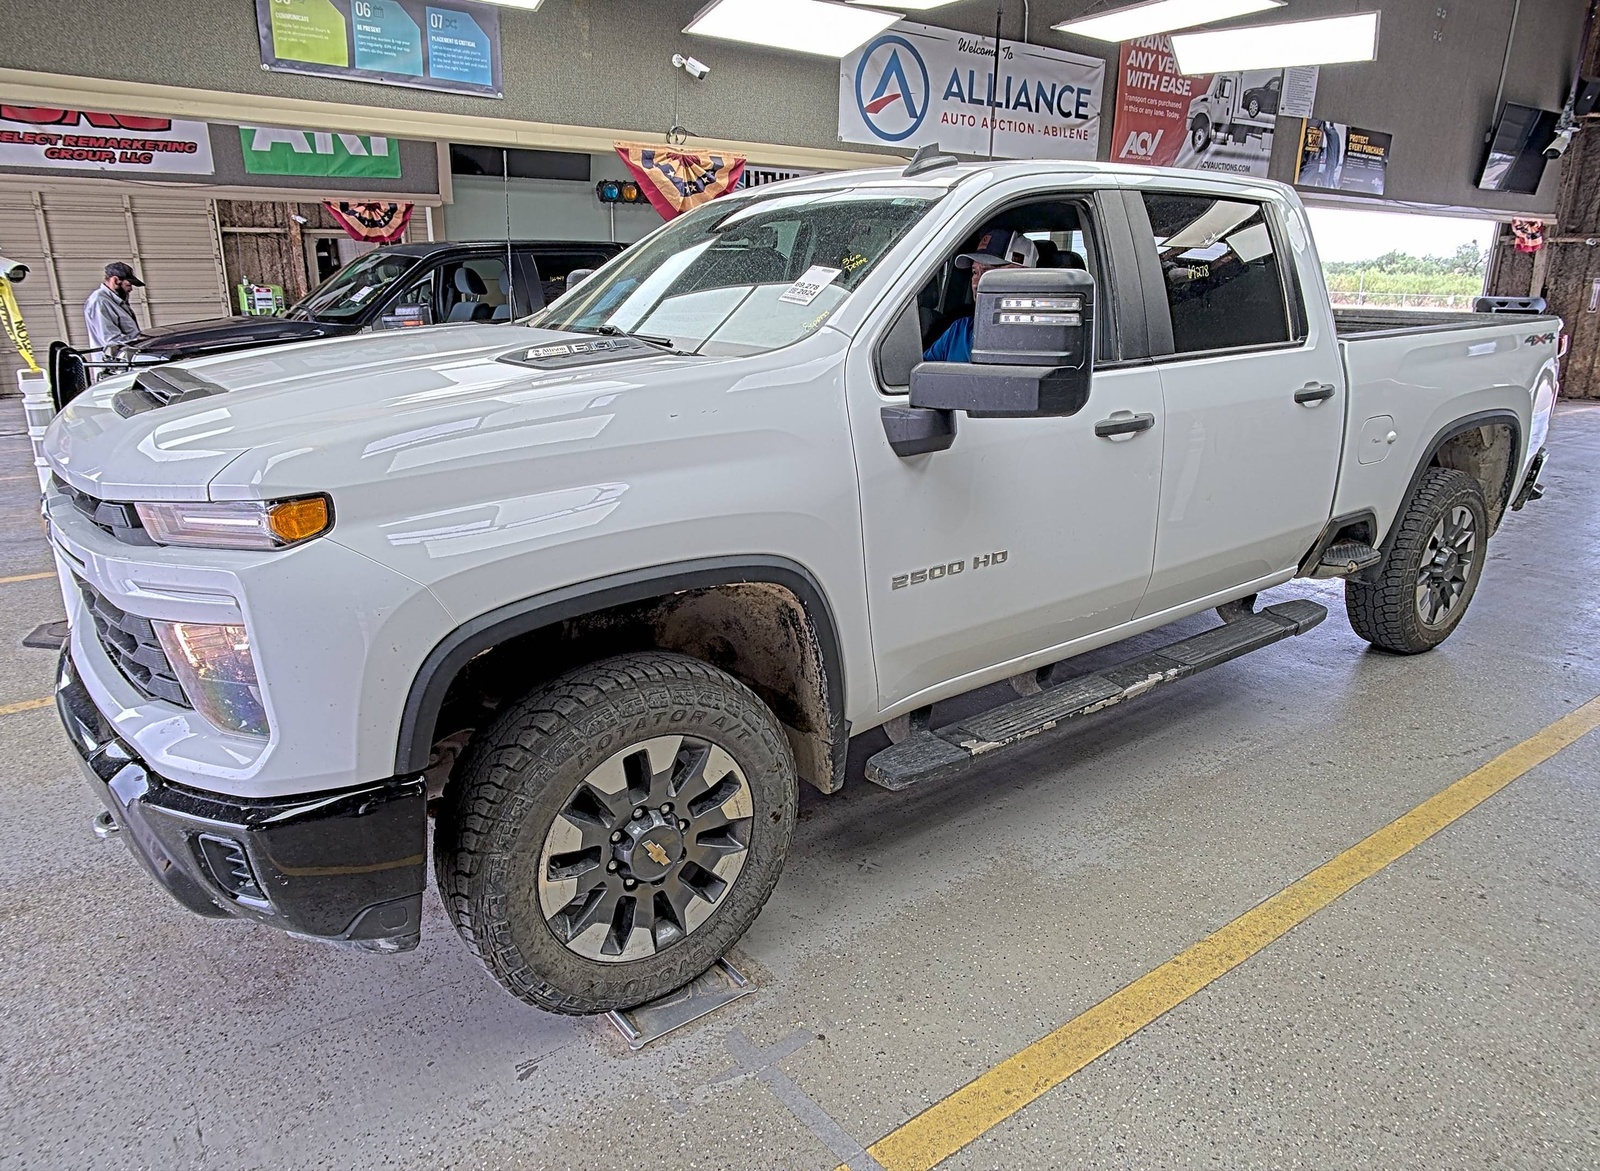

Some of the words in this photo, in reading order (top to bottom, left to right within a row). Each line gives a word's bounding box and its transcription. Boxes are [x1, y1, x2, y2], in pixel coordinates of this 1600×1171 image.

[355, 1, 371, 18] 06
[362, 25, 382, 34] PRESENT
[430, 13, 443, 29] 07
[432, 36, 453, 45] PLACEMENT
[459, 40, 476, 48] CRITICAL
[958, 37, 998, 58] Welcom
[1002, 46, 1014, 60] To
[1126, 50, 1156, 70] ANY
[1126, 69, 1160, 91] WITH
[1160, 76, 1192, 96] EASE.
[942, 67, 1092, 120] ALLIANCE
[1124, 92, 1146, 104] Transport
[1158, 100, 1182, 109] purchased
[1124, 104, 1128, 112] in
[941, 112, 976, 128] AUTO
[981, 117, 1035, 135] AUCTION
[1043, 125, 1089, 141] ABILENE
[0, 130, 62, 145] ELECT
[63, 134, 197, 153] REMARKETING
[1119, 130, 1164, 158] ACV
[1350, 134, 1369, 144] PROTECT
[45, 148, 116, 164] GROUP,
[119, 151, 153, 164] LLC
[892, 560, 964, 590] 2500
[973, 550, 1008, 570] HD
[578, 710, 708, 768] ROTATOR
[712, 716, 750, 740] A/T
